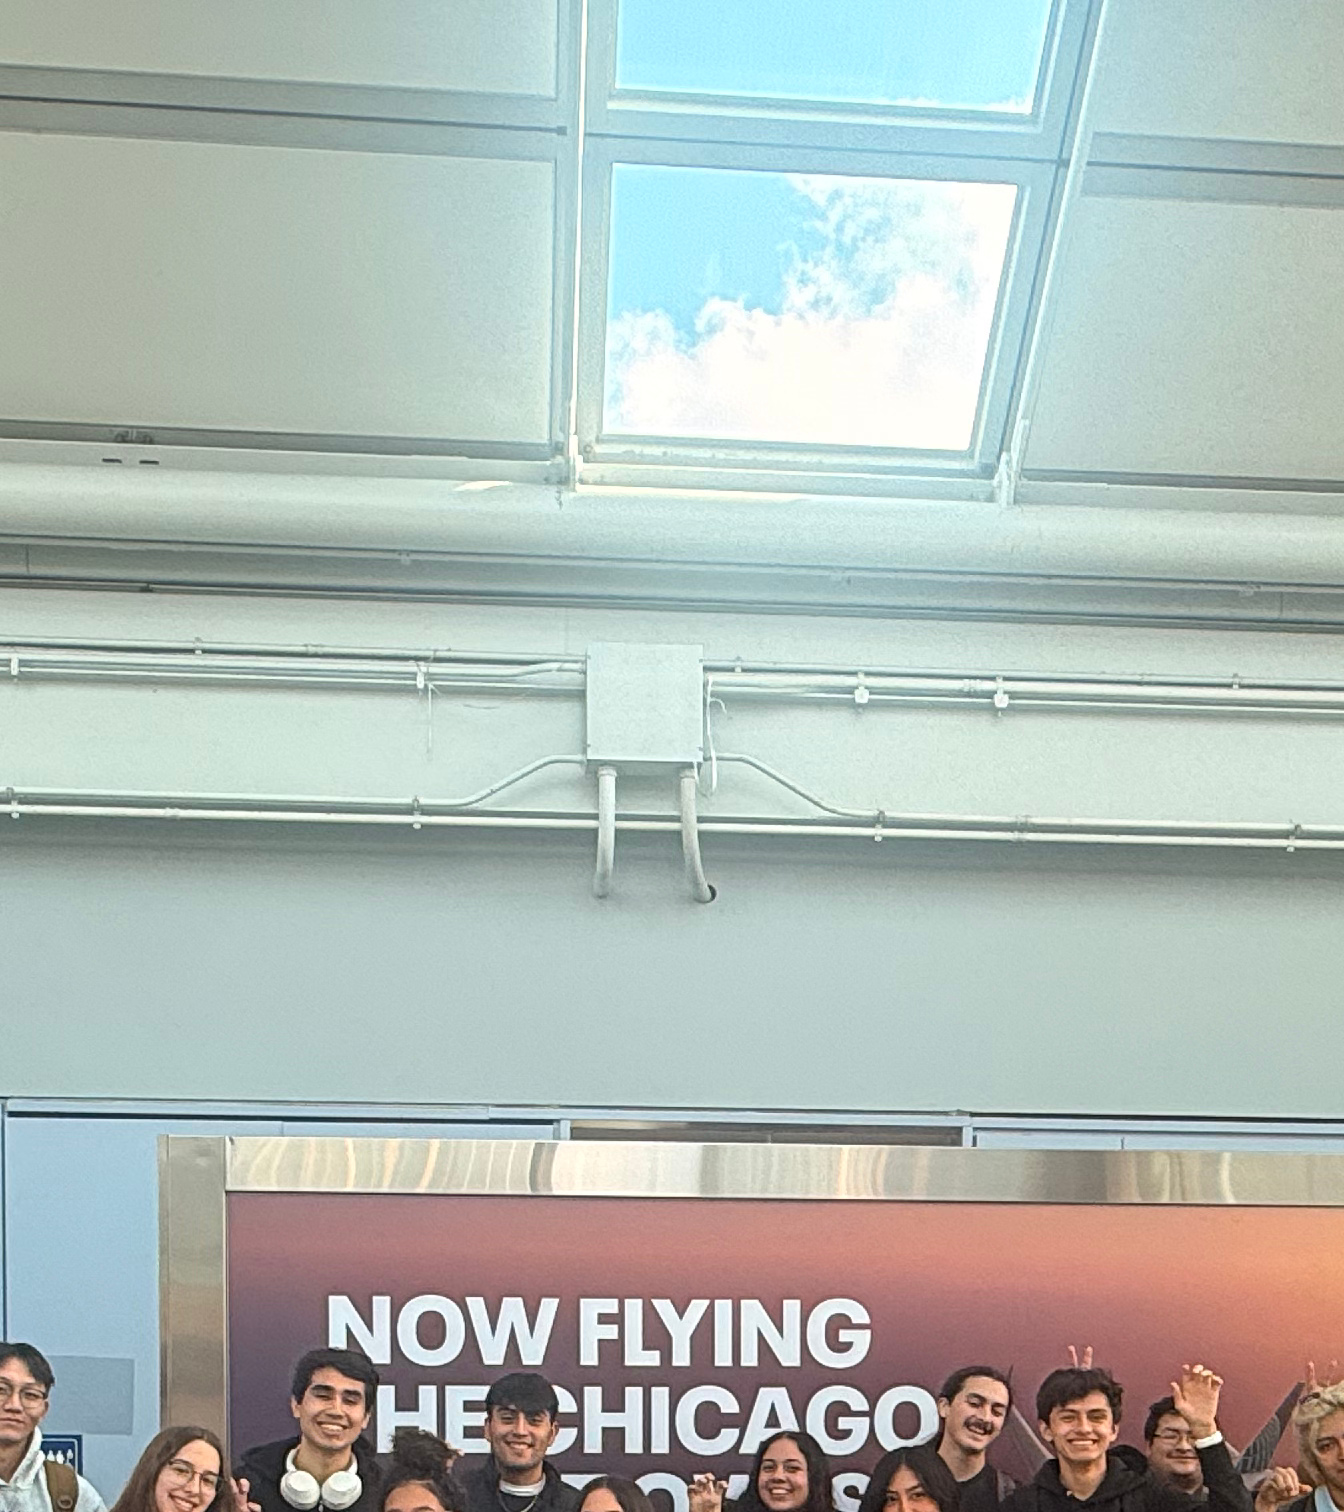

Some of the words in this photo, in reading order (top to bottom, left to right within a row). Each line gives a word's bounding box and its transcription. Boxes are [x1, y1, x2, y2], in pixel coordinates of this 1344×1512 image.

[328, 1294, 560, 1367] NOW
[579, 1297, 872, 1369] FLYING
[376, 1384, 492, 1454] HE
